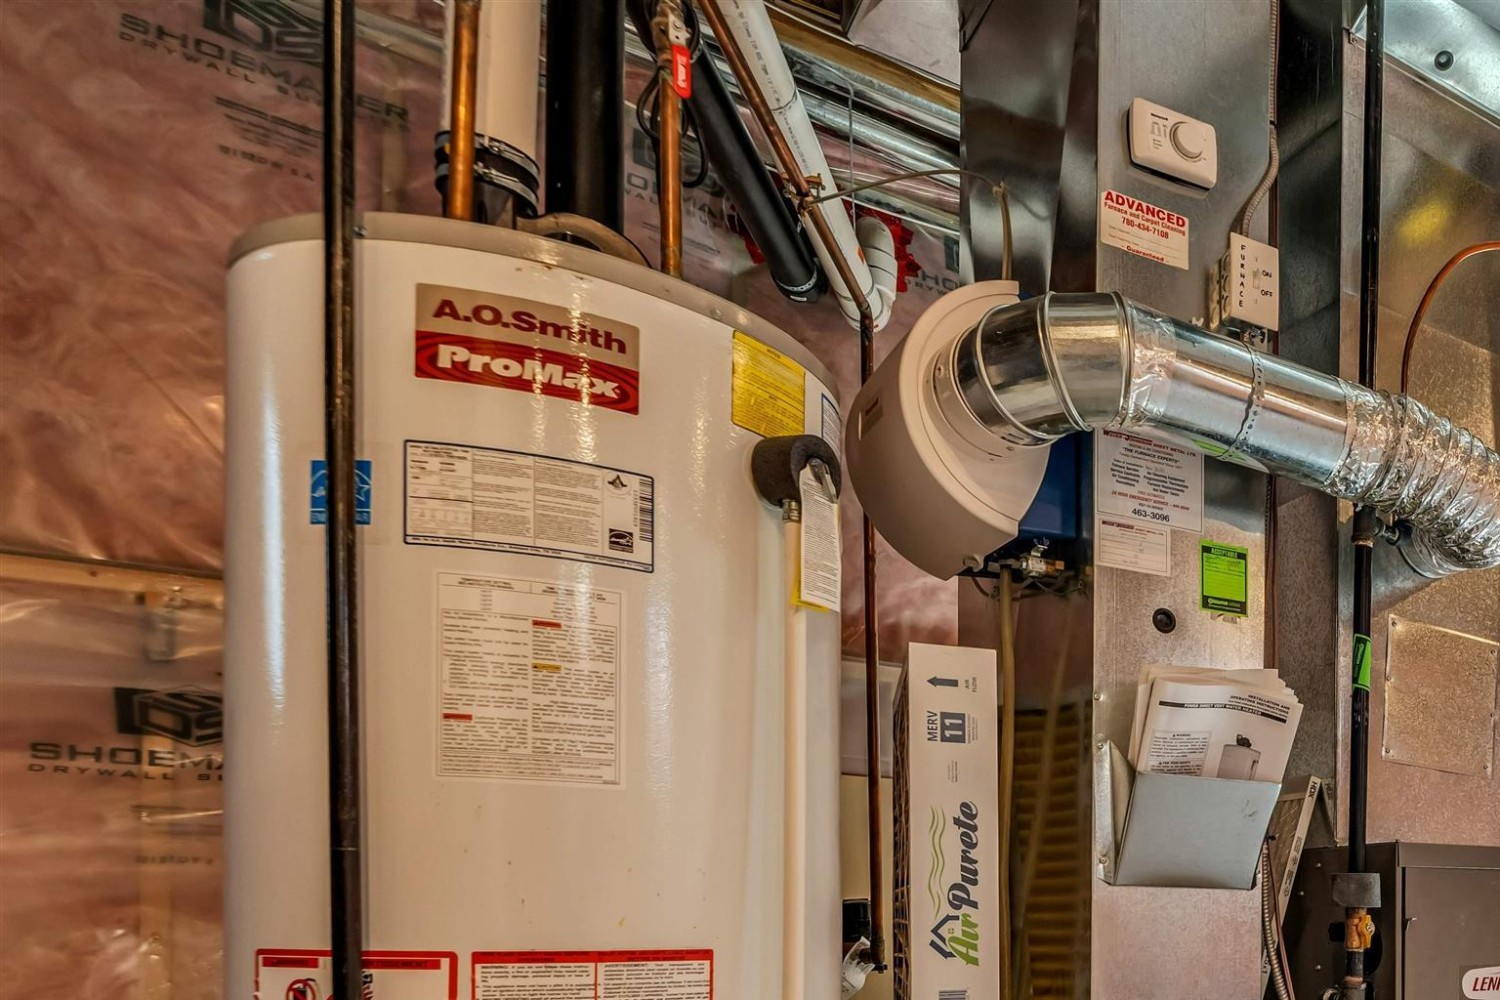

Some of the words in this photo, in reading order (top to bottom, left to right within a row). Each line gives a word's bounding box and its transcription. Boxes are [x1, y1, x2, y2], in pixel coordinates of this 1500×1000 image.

[118, 31, 256, 85] DRYWALL
[118, 11, 409, 122] SHOEMAER
[1104, 190, 1186, 228] ADVANCED
[1104, 201, 1128, 215] Furnace
[1129, 211, 1140, 219] and
[1141, 214, 1160, 227] Carpet
[1161, 221, 1186, 237] Cleaning
[1121, 216, 1169, 239] 780-434-7108
[1126, 245, 1165, 262] Guaranteed
[1261, 269, 1272, 279] ON
[1260, 289, 1273, 298] OFF
[432, 299, 628, 355] A.O.Smith
[436, 343, 621, 399] ProMax
[1131, 508, 1170, 522] 463-3096
[1230, 695, 1256, 704] OPERATING
[1256, 700, 1290, 715] INSTRUCTIONS
[1248, 694, 1280, 707] INSTALLATION
[927, 710, 938, 742] MERV
[943, 718, 963, 738] 11
[28, 742, 222, 768] SHOEM
[27, 763, 175, 781] DRYWALL
[1308, 781, 1318, 799] HDX
[946, 800, 980, 911] Purete
[947, 912, 980, 968] Air
